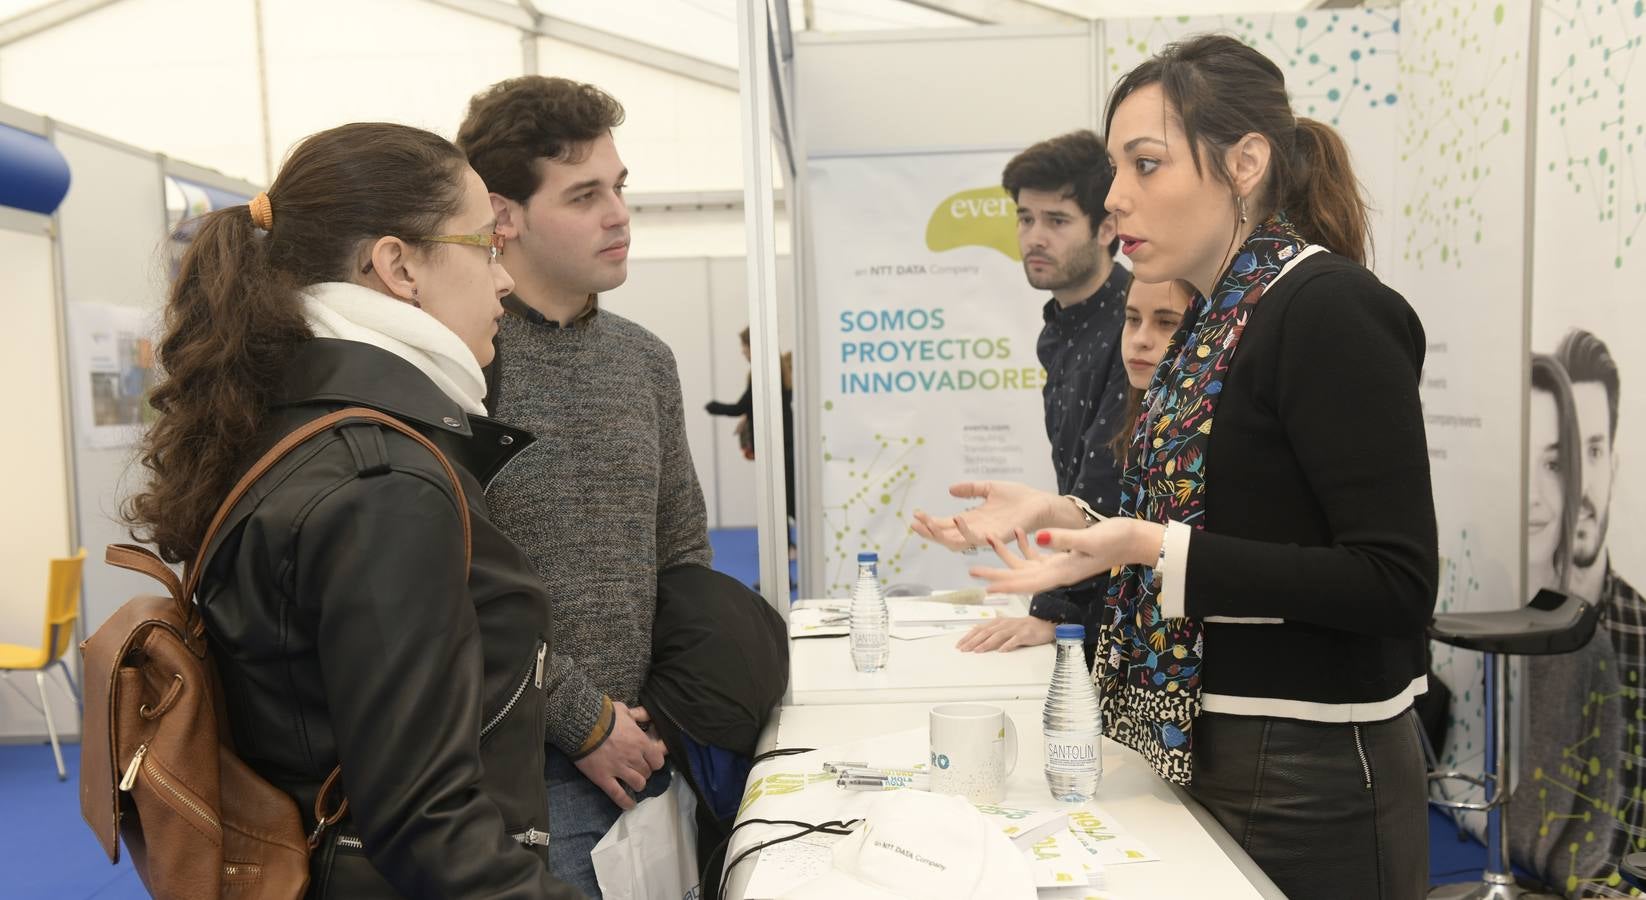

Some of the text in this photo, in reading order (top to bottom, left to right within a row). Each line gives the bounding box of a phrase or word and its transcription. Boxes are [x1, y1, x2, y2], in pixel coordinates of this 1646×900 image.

[951, 198, 1013, 219] ever
[870, 264, 893, 276] NTT
[896, 264, 927, 276] DATA
[930, 263, 980, 276] Company
[840, 308, 945, 333] SOMOS
[841, 338, 1011, 363] PROYECTOS
[931, 752, 950, 770] RO
[895, 846, 914, 860] DATA
[915, 854, 947, 872] Company
